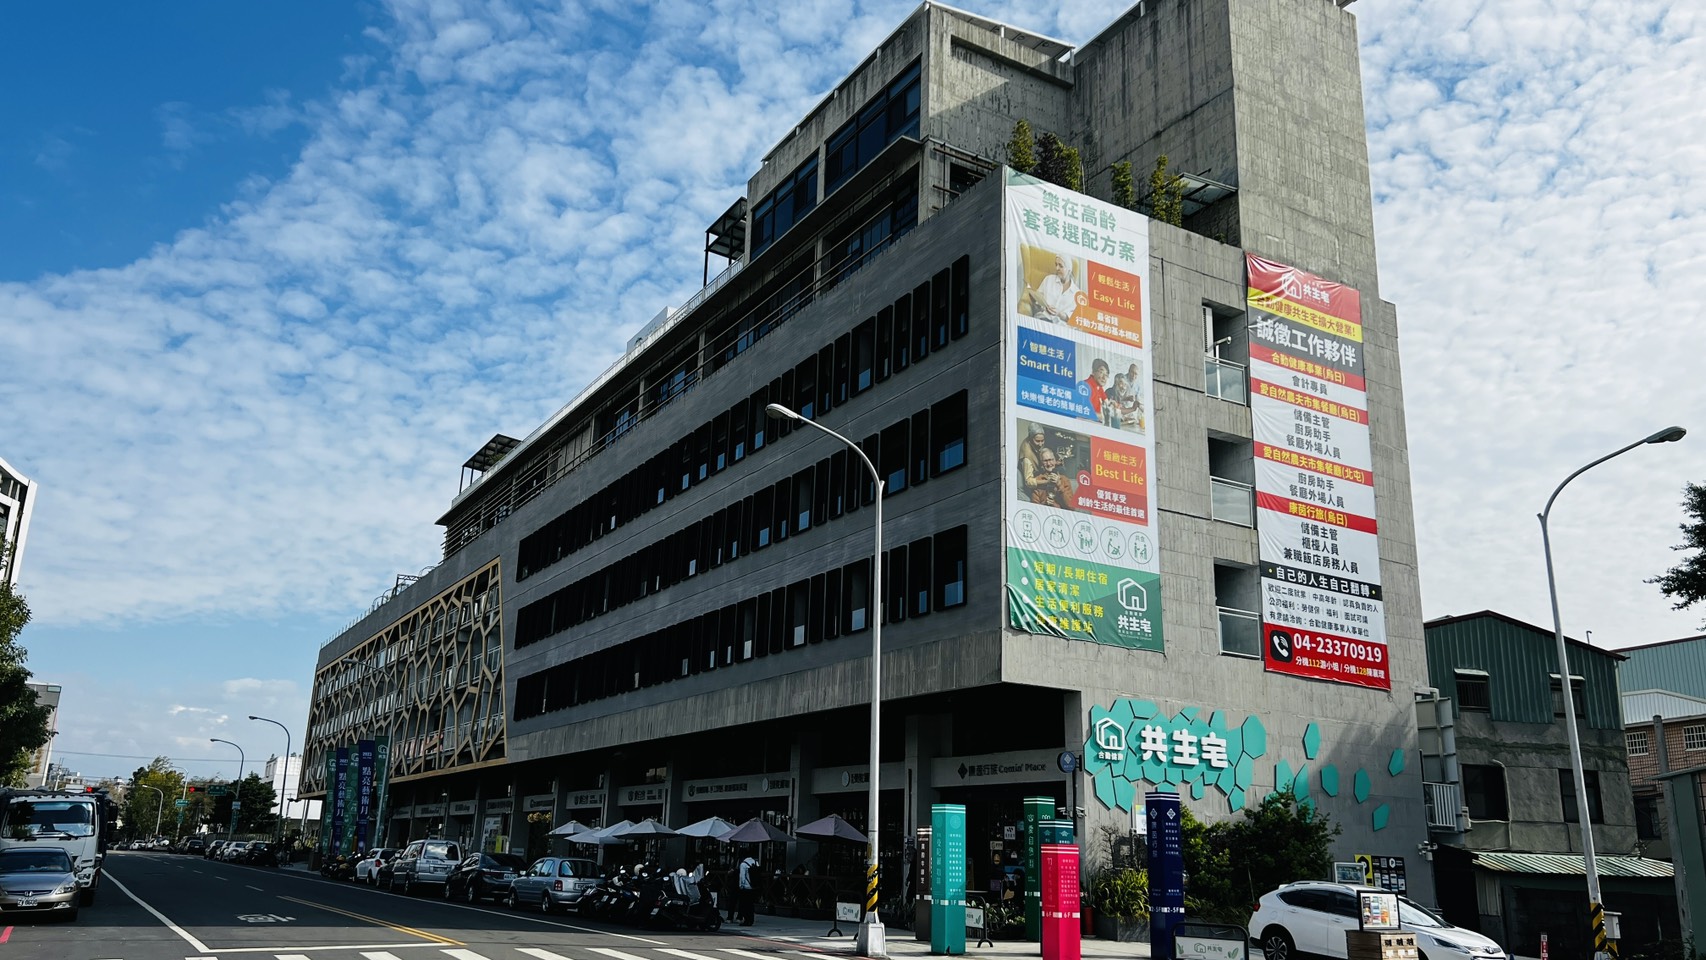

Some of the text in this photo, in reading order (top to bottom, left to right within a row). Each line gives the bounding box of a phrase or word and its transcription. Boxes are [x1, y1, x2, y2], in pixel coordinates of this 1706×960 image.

[1042, 190, 1116, 232] 樂在高齡
[1023, 208, 1135, 263] 套餐選配方案
[1093, 290, 1135, 310] Easy Life
[1303, 284, 1330, 304] 共生宅
[1030, 342, 1064, 360] 智慧生活
[1257, 316, 1356, 367] 誠徵工作夥伴
[1020, 355, 1073, 378] Smart Life
[1042, 384, 1072, 400] 基本配備
[1292, 375, 1327, 395] 會計專員
[1260, 383, 1360, 422] 愛自然農夫市集餐廳(烏日)
[1294, 409, 1330, 429] 儲備主管
[1295, 424, 1331, 442] 廚房助手
[1286, 434, 1341, 459] 餐廳外場人員
[1096, 464, 1144, 485] Best Life
[1264, 446, 1364, 483] 愛自然農夫市集餐廳(北屯)
[1298, 472, 1334, 492] 廚房助手
[1289, 484, 1344, 508] 餐廳外場人員
[1289, 502, 1348, 528] 康茵行旅(烏日)
[1301, 522, 1338, 541] 儲備主管
[1284, 547, 1359, 574] 兼職飯店房務人員
[1035, 578, 1080, 596] 居家清潔
[1276, 567, 1369, 597] 自己的人生自己翻轉
[1035, 596, 1104, 617] 生活便利服務
[1118, 615, 1152, 633] 共生宅
[1294, 633, 1382, 663] 04-23370919
[1140, 724, 1229, 768] 共生宅
[360, 767, 371, 815] 點亮藝術月
